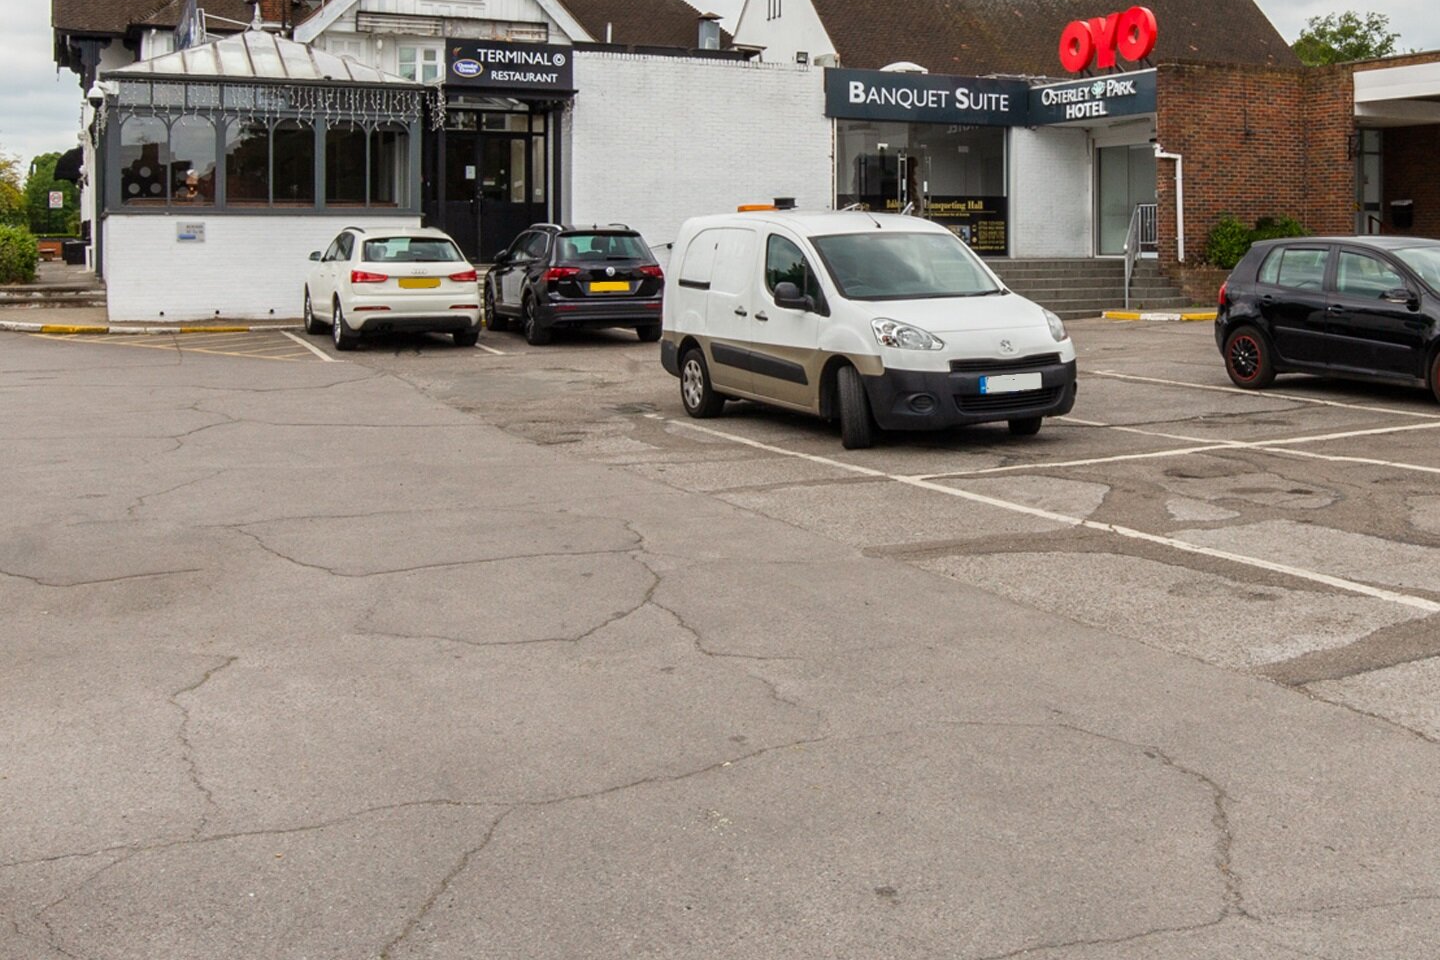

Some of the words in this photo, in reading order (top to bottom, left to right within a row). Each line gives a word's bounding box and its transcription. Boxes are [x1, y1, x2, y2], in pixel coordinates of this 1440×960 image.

[1058, 5, 1158, 73] OYO
[491, 70, 558, 83] RESTAURANT
[849, 81, 950, 109] BANQUET
[955, 87, 1010, 112] SUITE
[1106, 79, 1137, 98] PARK
[1065, 101, 1108, 119] HOTEL
